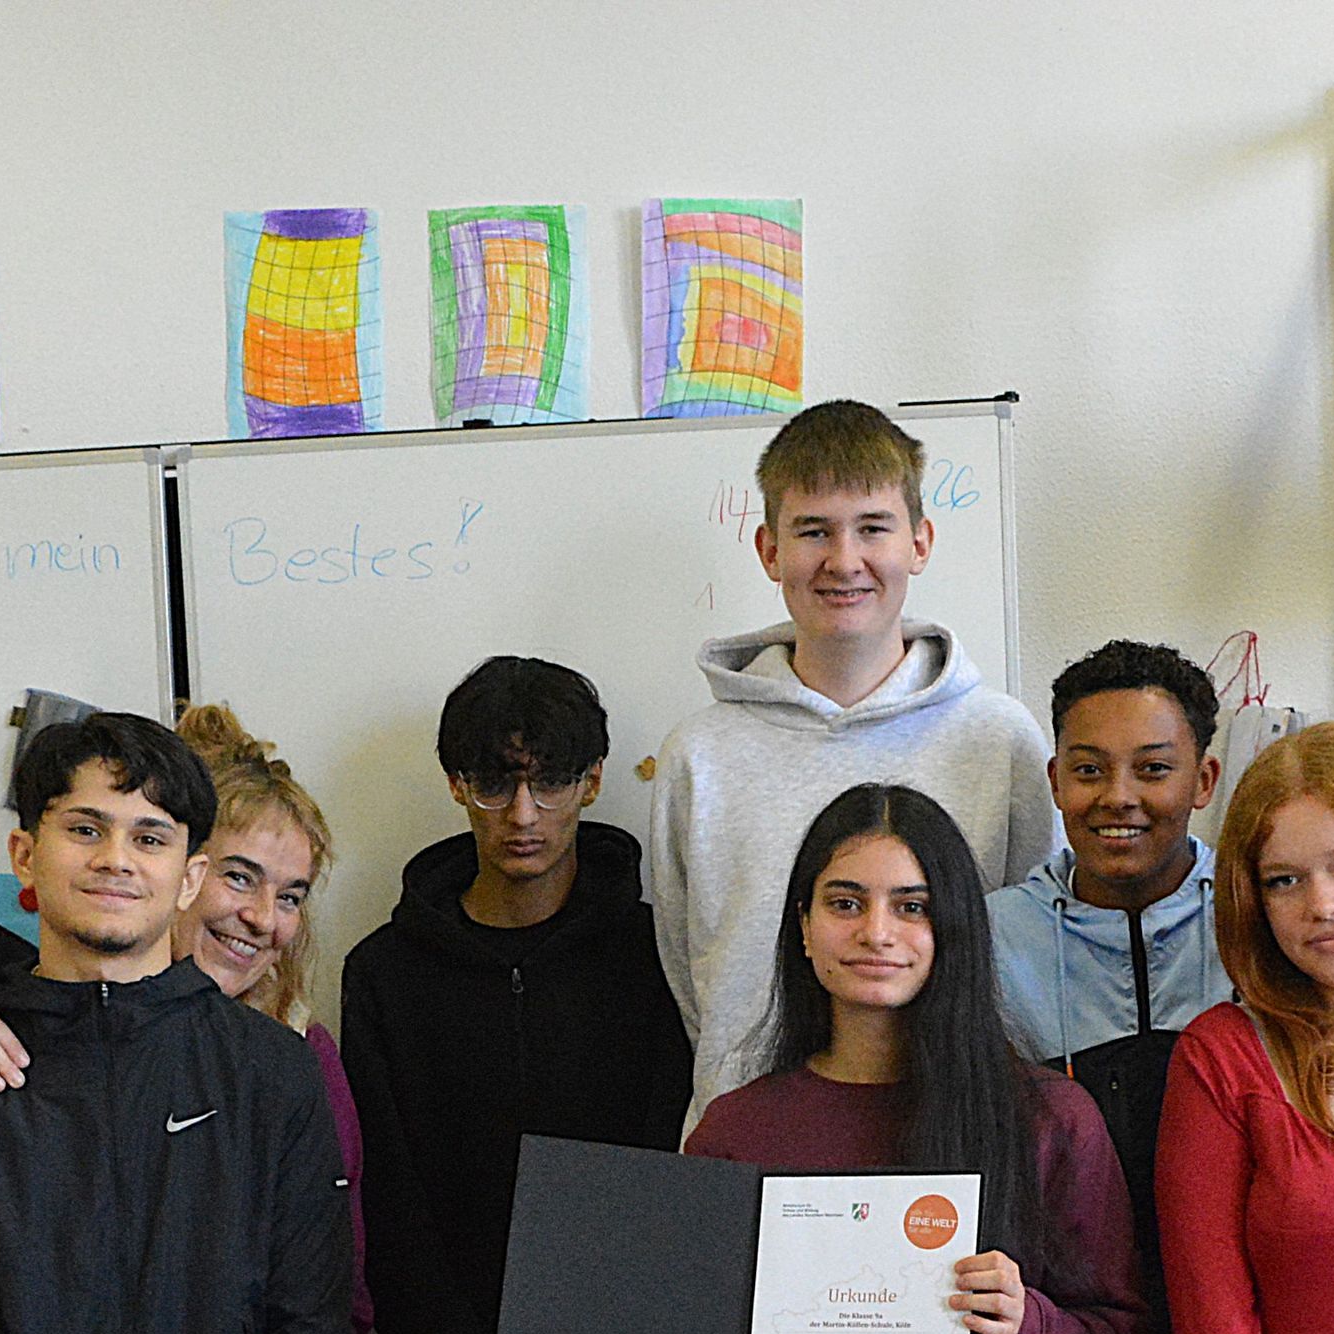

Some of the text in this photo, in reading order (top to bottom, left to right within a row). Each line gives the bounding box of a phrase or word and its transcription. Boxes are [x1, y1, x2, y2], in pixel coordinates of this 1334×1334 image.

[6, 533, 121, 580] mein
[909, 1216, 956, 1228] EINE WELT
[828, 1287, 898, 1304] Urkunde
